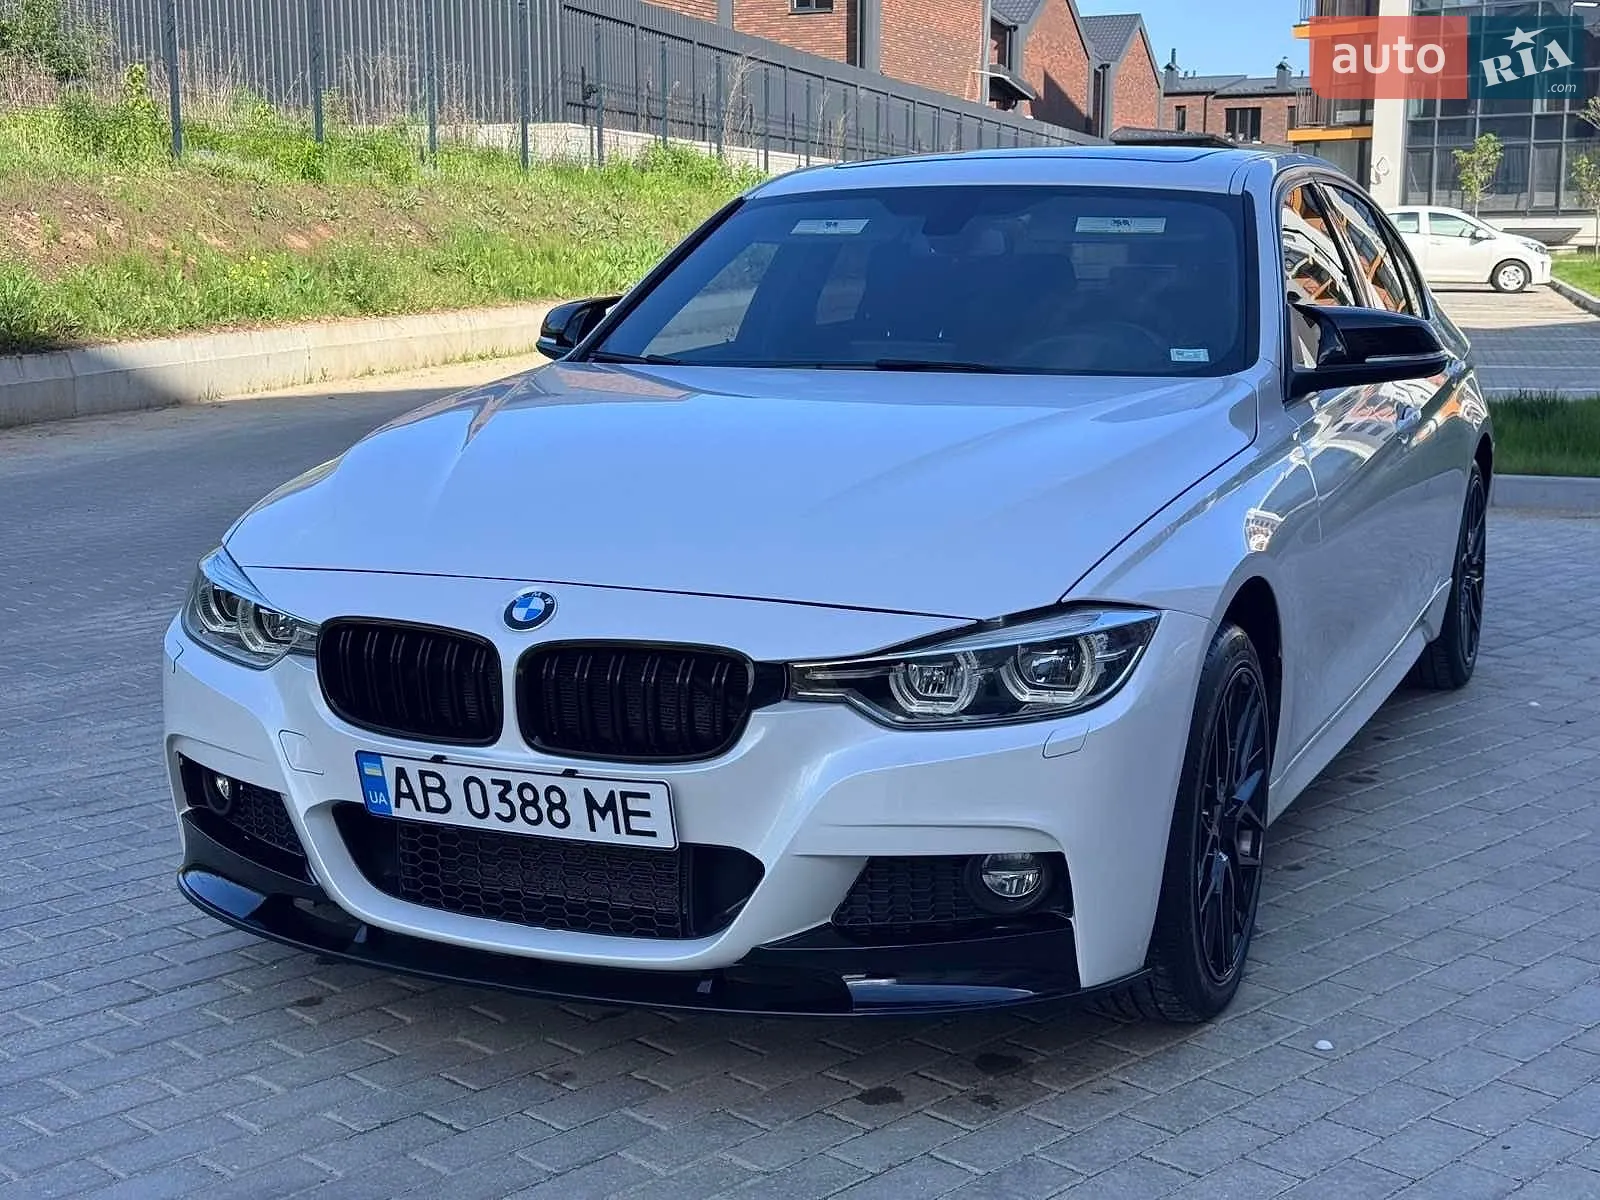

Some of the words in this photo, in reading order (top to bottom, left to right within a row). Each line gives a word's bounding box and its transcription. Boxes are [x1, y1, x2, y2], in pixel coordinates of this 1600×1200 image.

[369, 790, 388, 807] UA
[394, 766, 452, 814] AB
[462, 775, 571, 829] 0388
[584, 787, 657, 838] ME
